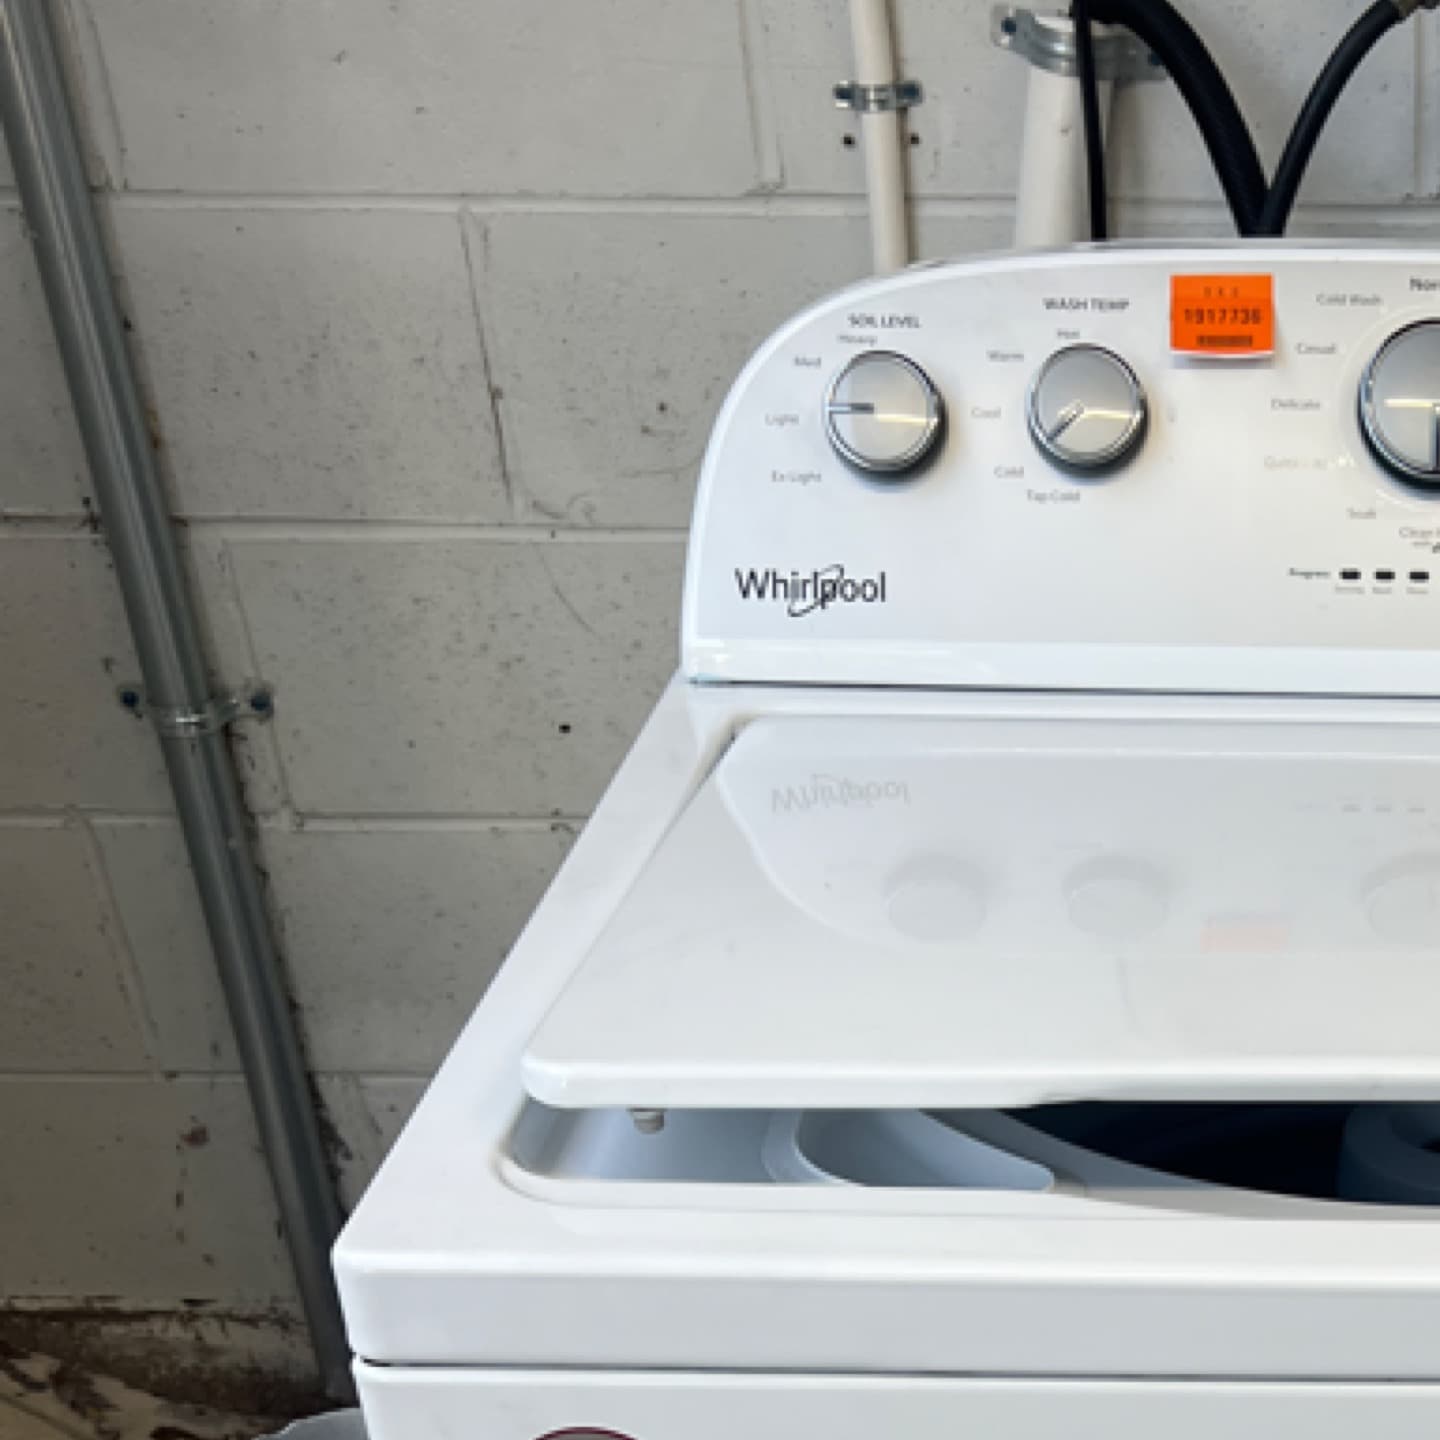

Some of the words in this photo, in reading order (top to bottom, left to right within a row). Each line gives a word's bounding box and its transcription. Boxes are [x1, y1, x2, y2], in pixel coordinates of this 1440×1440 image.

[1042, 297, 1088, 311] WASH
[848, 313, 878, 328] SOIL
[881, 314, 921, 328] LEVEL
[735, 567, 886, 614] Whirlpool
